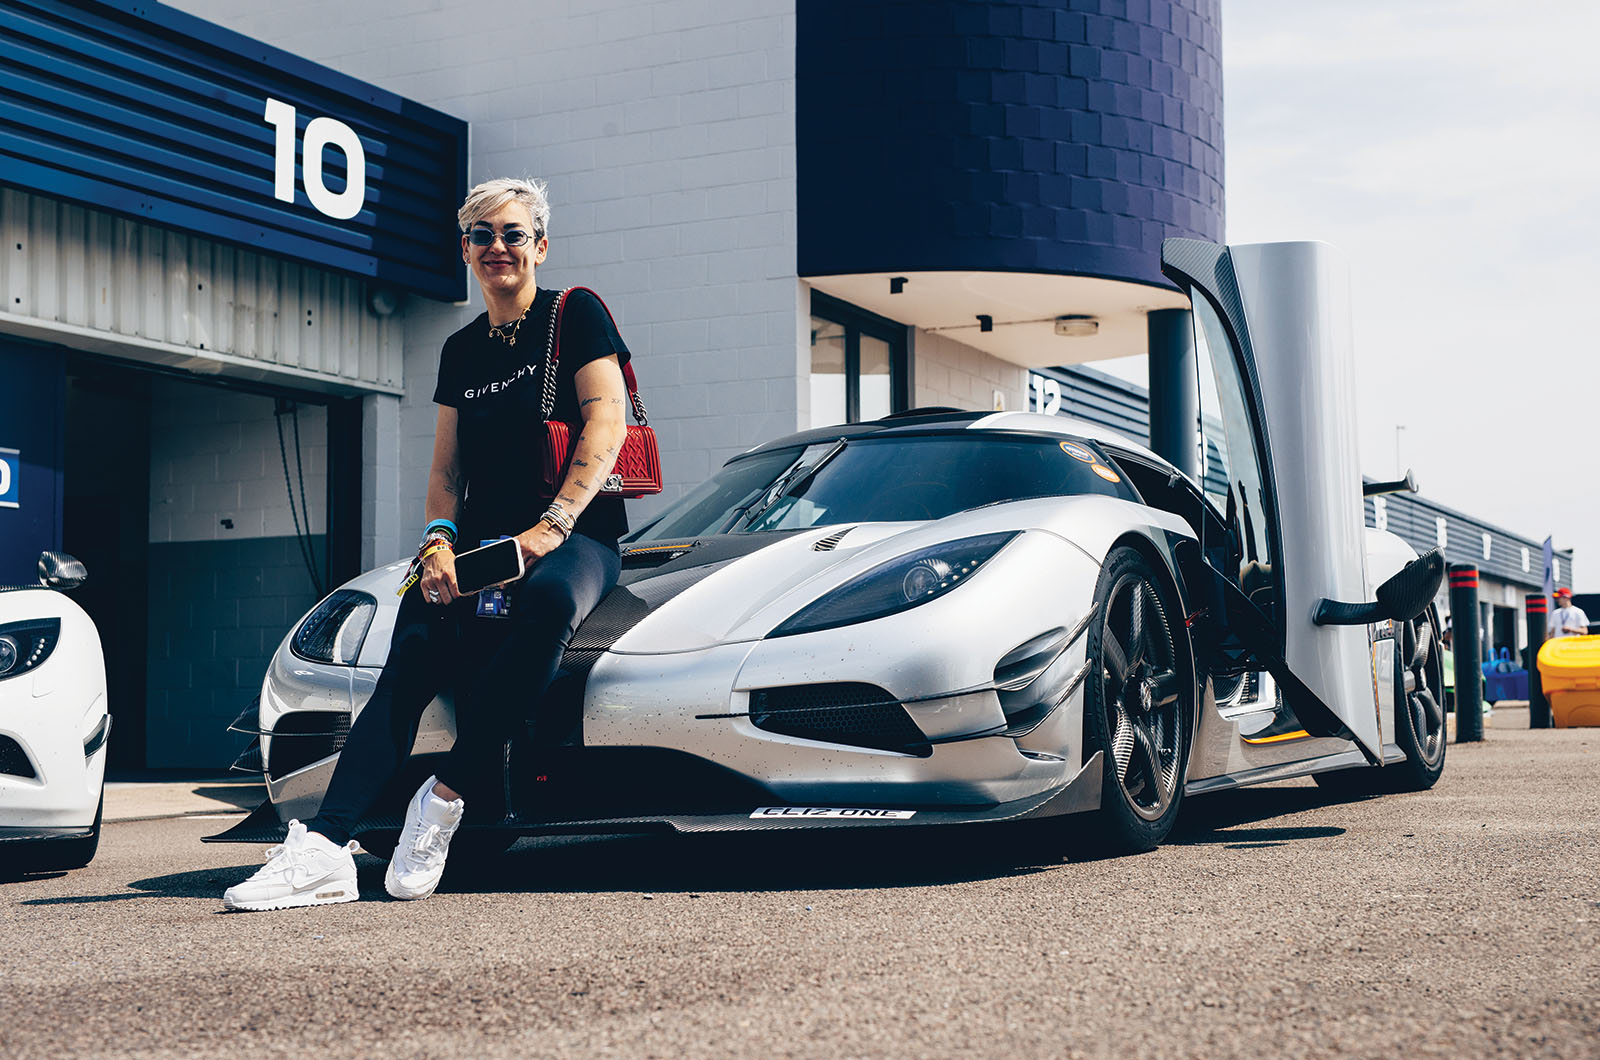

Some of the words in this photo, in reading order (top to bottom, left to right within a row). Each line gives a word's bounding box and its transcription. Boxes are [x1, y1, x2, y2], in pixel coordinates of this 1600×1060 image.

[264, 97, 366, 220] 10
[464, 364, 537, 399] GIVENCHY
[1033, 374, 1062, 416] 12
[839, 808, 901, 818] ONE
